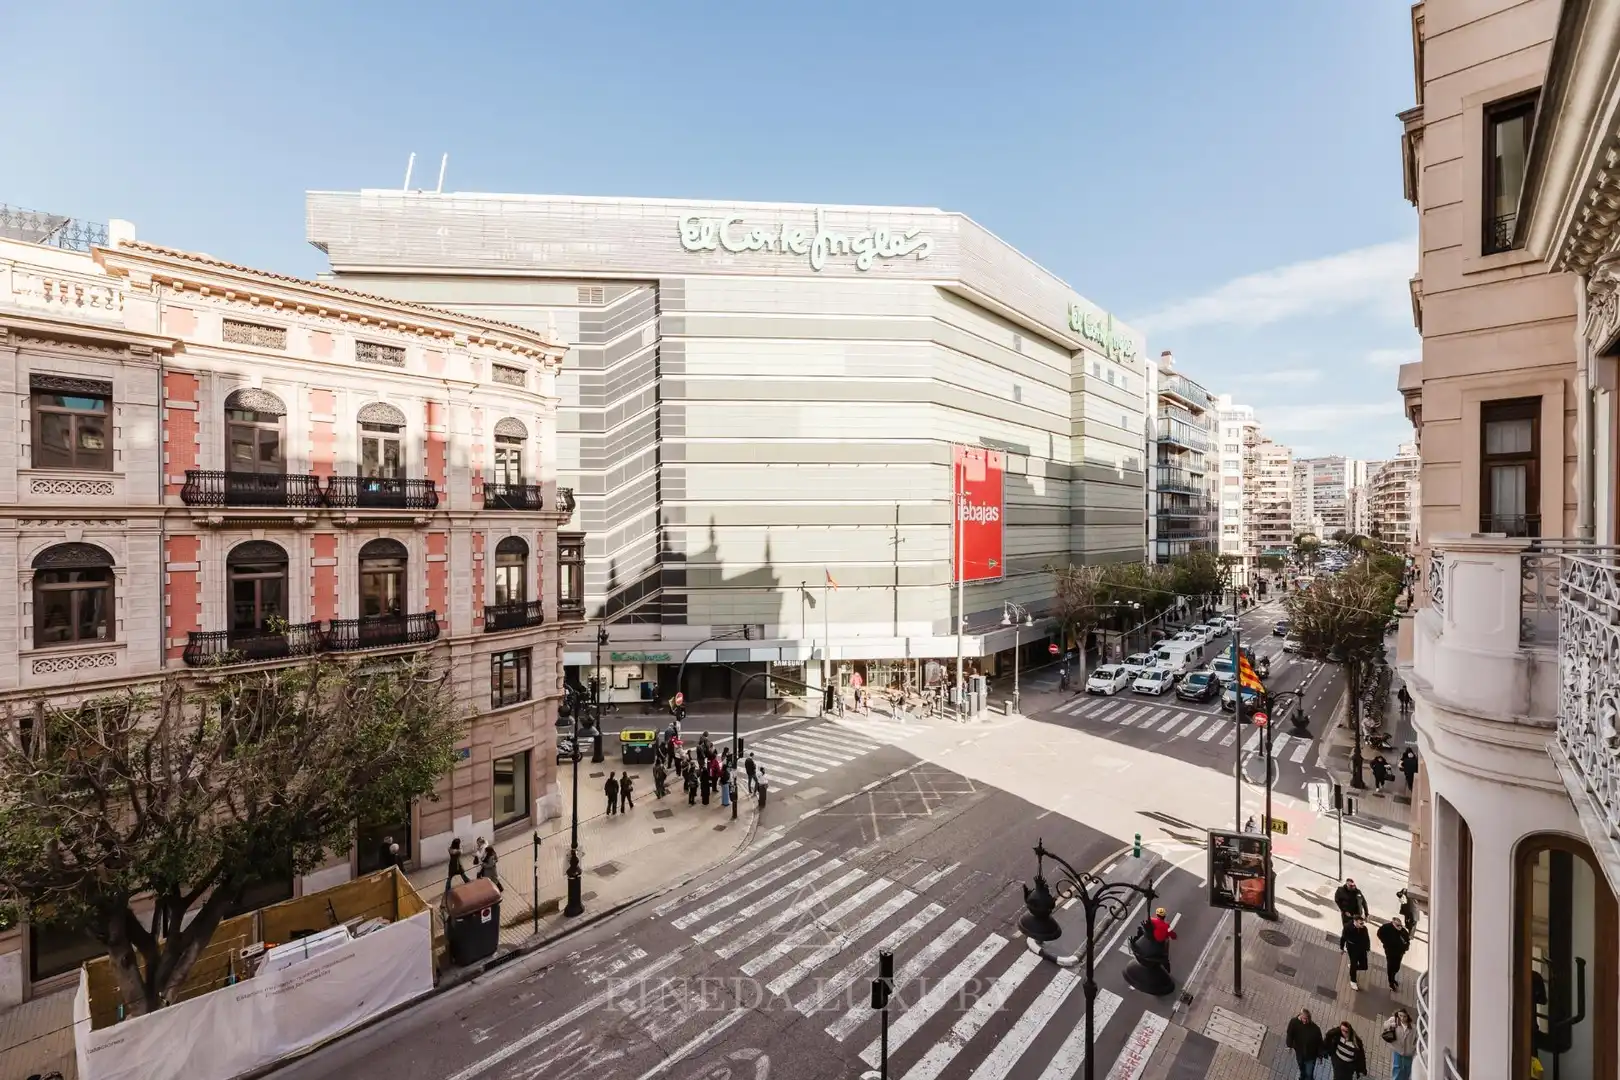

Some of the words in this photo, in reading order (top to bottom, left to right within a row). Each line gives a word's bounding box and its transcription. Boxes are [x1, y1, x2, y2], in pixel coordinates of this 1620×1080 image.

[679, 211, 717, 251] El
[718, 211, 808, 255] Corte
[808, 207, 936, 271] Inglés
[773, 659, 805, 667] SAMSUNG
